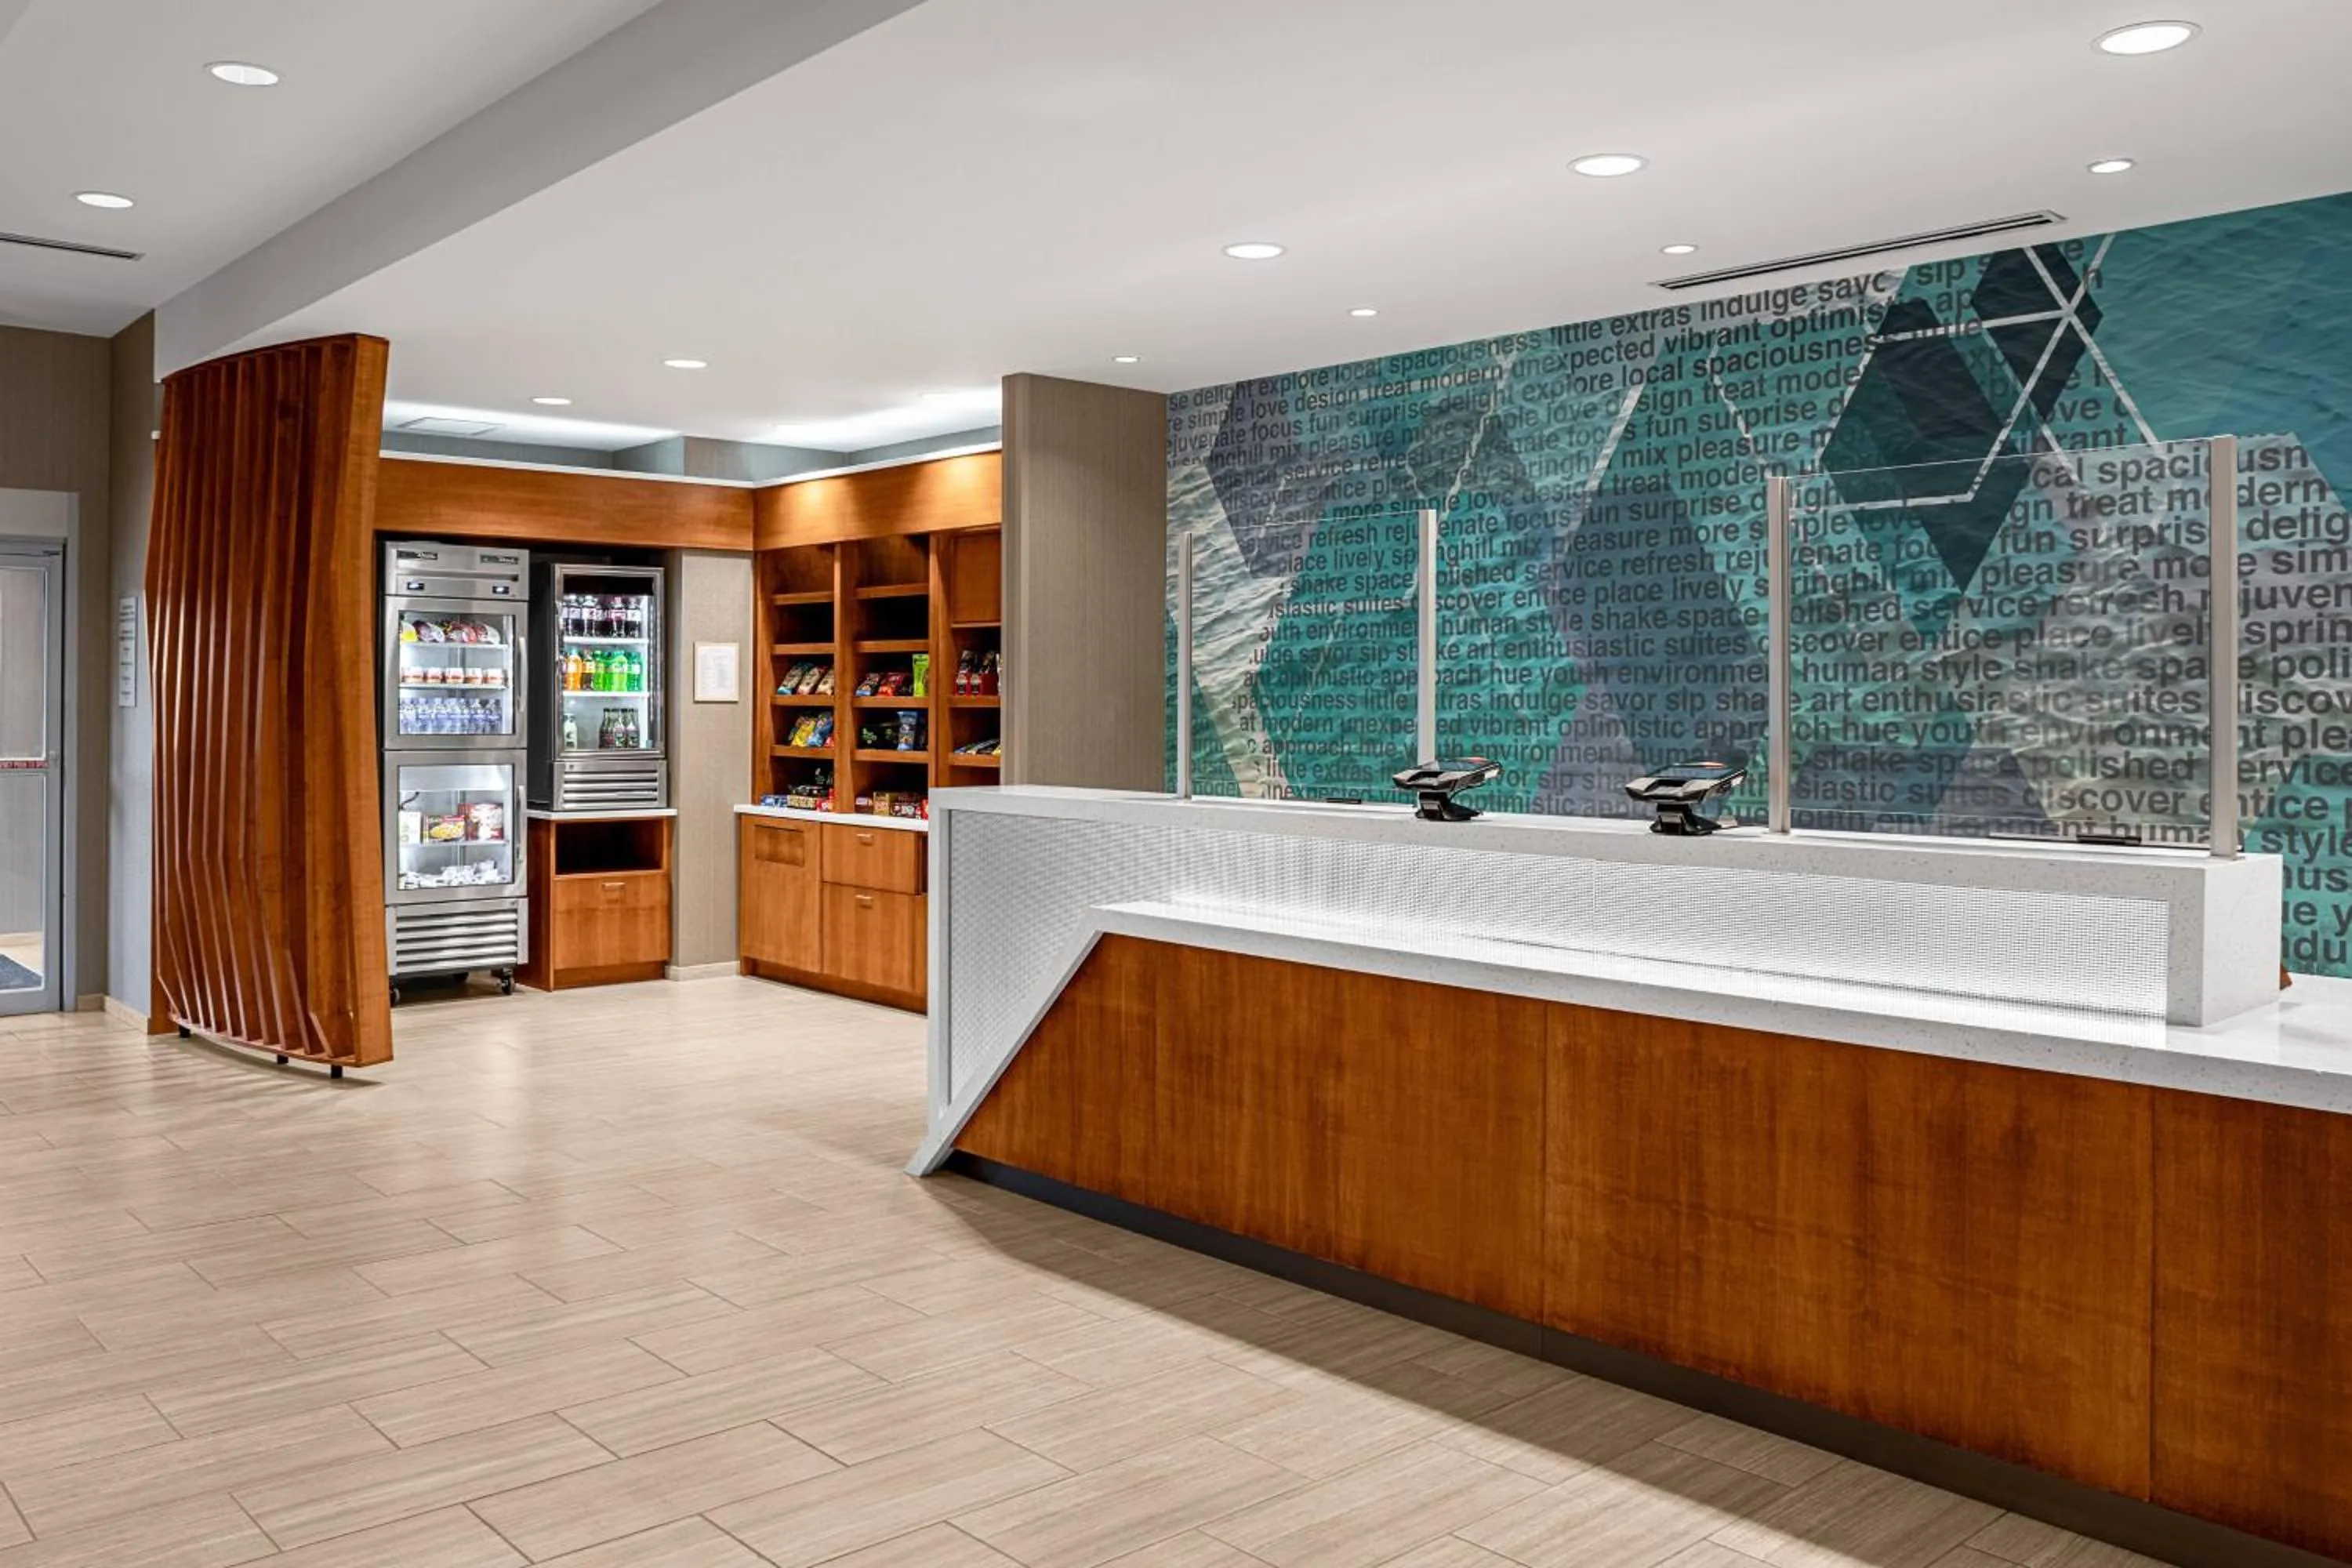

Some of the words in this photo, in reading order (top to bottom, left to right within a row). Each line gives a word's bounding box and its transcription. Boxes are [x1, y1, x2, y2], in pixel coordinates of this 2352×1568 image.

[1192, 379, 1252, 407] delight
[1258, 368, 1329, 397] explore
[1334, 357, 1380, 383] local
[1389, 332, 1541, 376] spaciousness
[1549, 320, 1602, 347] little
[1610, 305, 1691, 337] extras
[1700, 285, 1807, 322] indulge
[1915, 257, 1965, 288] sip
[1187, 403, 1245, 429] simple
[1250, 398, 1289, 419] love
[1294, 387, 1360, 412] design
[1366, 376, 1412, 401] treat
[1419, 364, 1503, 394] modern
[1510, 334, 1655, 379] unexpected
[1662, 318, 1762, 356] vibrant
[1250, 419, 1303, 441] focus
[1308, 412, 1340, 434] fun
[1347, 399, 1431, 428] surprise
[1439, 383, 1514, 415] delight
[1521, 372, 1613, 404] explore
[1621, 357, 1683, 389] local
[1269, 439, 1302, 461] mix
[1308, 429, 1394, 461] pleasure
[1546, 401, 1599, 426] love
[1604, 388, 1693, 418] dsign
[1702, 374, 1767, 405] treat
[1283, 457, 1353, 482] service
[1566, 423, 1636, 448] focs
[1646, 416, 1687, 440] fun
[1697, 400, 1817, 434] surprise
[1621, 443, 1668, 469] mix
[1677, 431, 1800, 469] pleasure
[1308, 522, 1377, 548] refresh
[1505, 510, 1570, 532] focus
[1627, 492, 1740, 524] surprise
[1331, 502, 1384, 523] more
[1467, 488, 1510, 510] love
[1612, 470, 1671, 497] treat
[1680, 461, 1788, 491] modern
[1333, 546, 1385, 572] lively
[1501, 534, 1543, 557] mix
[1552, 528, 1661, 560] pleasure
[1669, 522, 1740, 546] more
[2067, 487, 2154, 519] treat
[2165, 477, 2327, 512] mdern
[1290, 572, 1348, 595] shake
[1353, 572, 1413, 596] space
[1436, 561, 1516, 586] olished
[1524, 556, 1613, 582] service
[1620, 547, 1714, 576] refresh
[1998, 528, 2055, 555] fun
[2068, 517, 2208, 555] surpris
[1341, 594, 1404, 615] suites
[1513, 584, 1586, 608] entice
[1594, 580, 1664, 610] place
[1671, 575, 1744, 604] lively
[1980, 558, 2139, 593] pleasure
[2152, 552, 2257, 579] moe
[1298, 646, 1355, 663] savor
[1359, 641, 1389, 666] sip
[1396, 639, 1460, 661] shke
[1466, 639, 1497, 659] art
[1502, 633, 1655, 659] enthusiastic
[1664, 632, 1748, 655] suites
[1898, 624, 2003, 651] entice
[2014, 621, 2112, 655] place
[1441, 614, 1516, 636] human
[1525, 609, 1583, 637] style
[1590, 605, 1668, 631] shake
[1675, 606, 1760, 633] space
[1789, 595, 1900, 624] olished
[1913, 592, 2038, 620] service
[1489, 662, 1532, 684] hue
[1540, 661, 1608, 689] youth
[1802, 657, 1909, 682] human
[1920, 654, 2003, 687] style
[2014, 652, 2127, 681] shake
[2136, 655, 2257, 686] spae
[1261, 712, 1334, 732] modern
[1469, 713, 1550, 735] vibrant
[1557, 714, 1685, 742] optimistic
[1842, 716, 1900, 742] hue
[1363, 688, 1409, 709] little
[1490, 688, 1577, 715] indulge
[1584, 692, 1657, 710] savor
[1664, 688, 1706, 716] sip
[1715, 687, 1802, 711] shae
[1810, 688, 1851, 711] art
[1861, 685, 2071, 712] enthusiastic
[1261, 735, 1352, 759] approach
[1813, 745, 1904, 772] shake
[1312, 760, 1373, 780] extras
[1537, 766, 1571, 793] sip
[2022, 780, 2184, 814] discover
